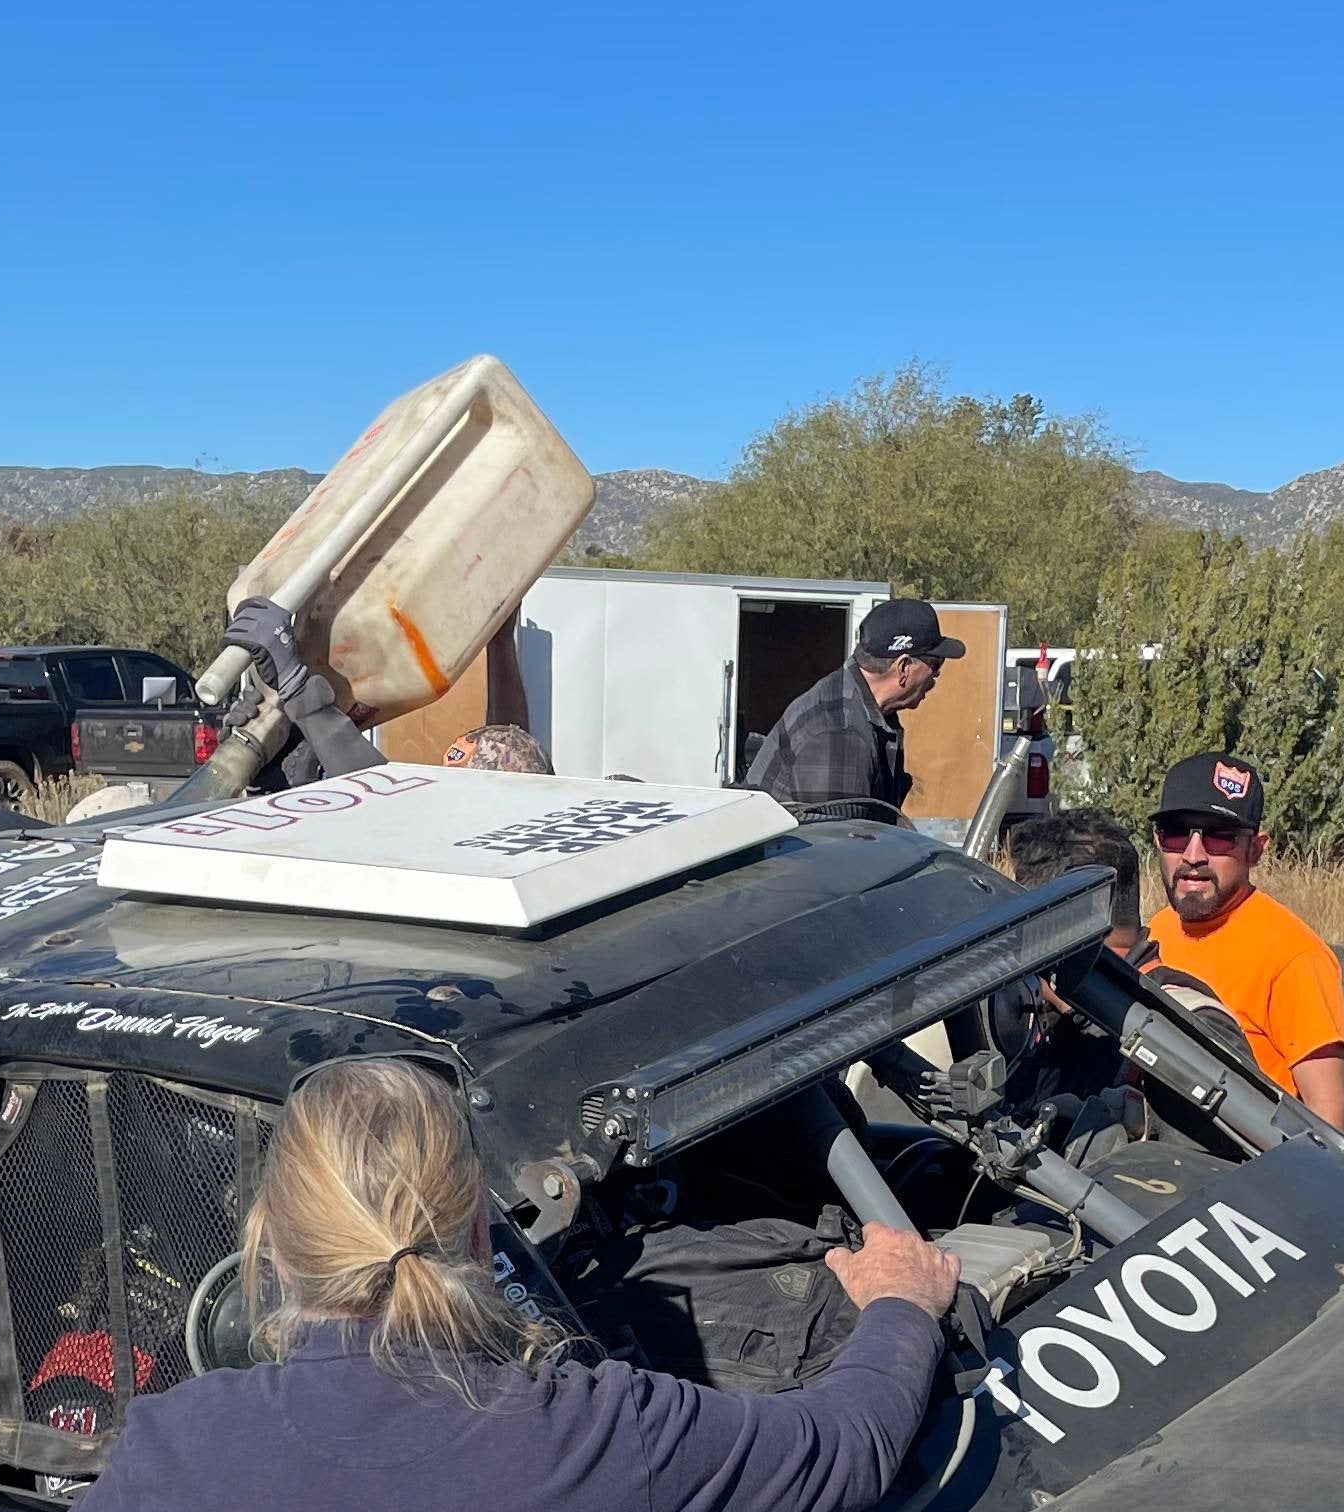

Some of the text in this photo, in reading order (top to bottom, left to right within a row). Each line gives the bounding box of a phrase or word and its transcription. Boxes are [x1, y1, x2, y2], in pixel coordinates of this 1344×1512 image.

[454, 799, 619, 848] SYSTEMS
[484, 801, 674, 856] MOUNT
[536, 808, 689, 853] STAR
[77, 1008, 174, 1034] Dennis
[173, 1015, 260, 1048] Hagen
[971, 1201, 1307, 1445] TOYOTA
